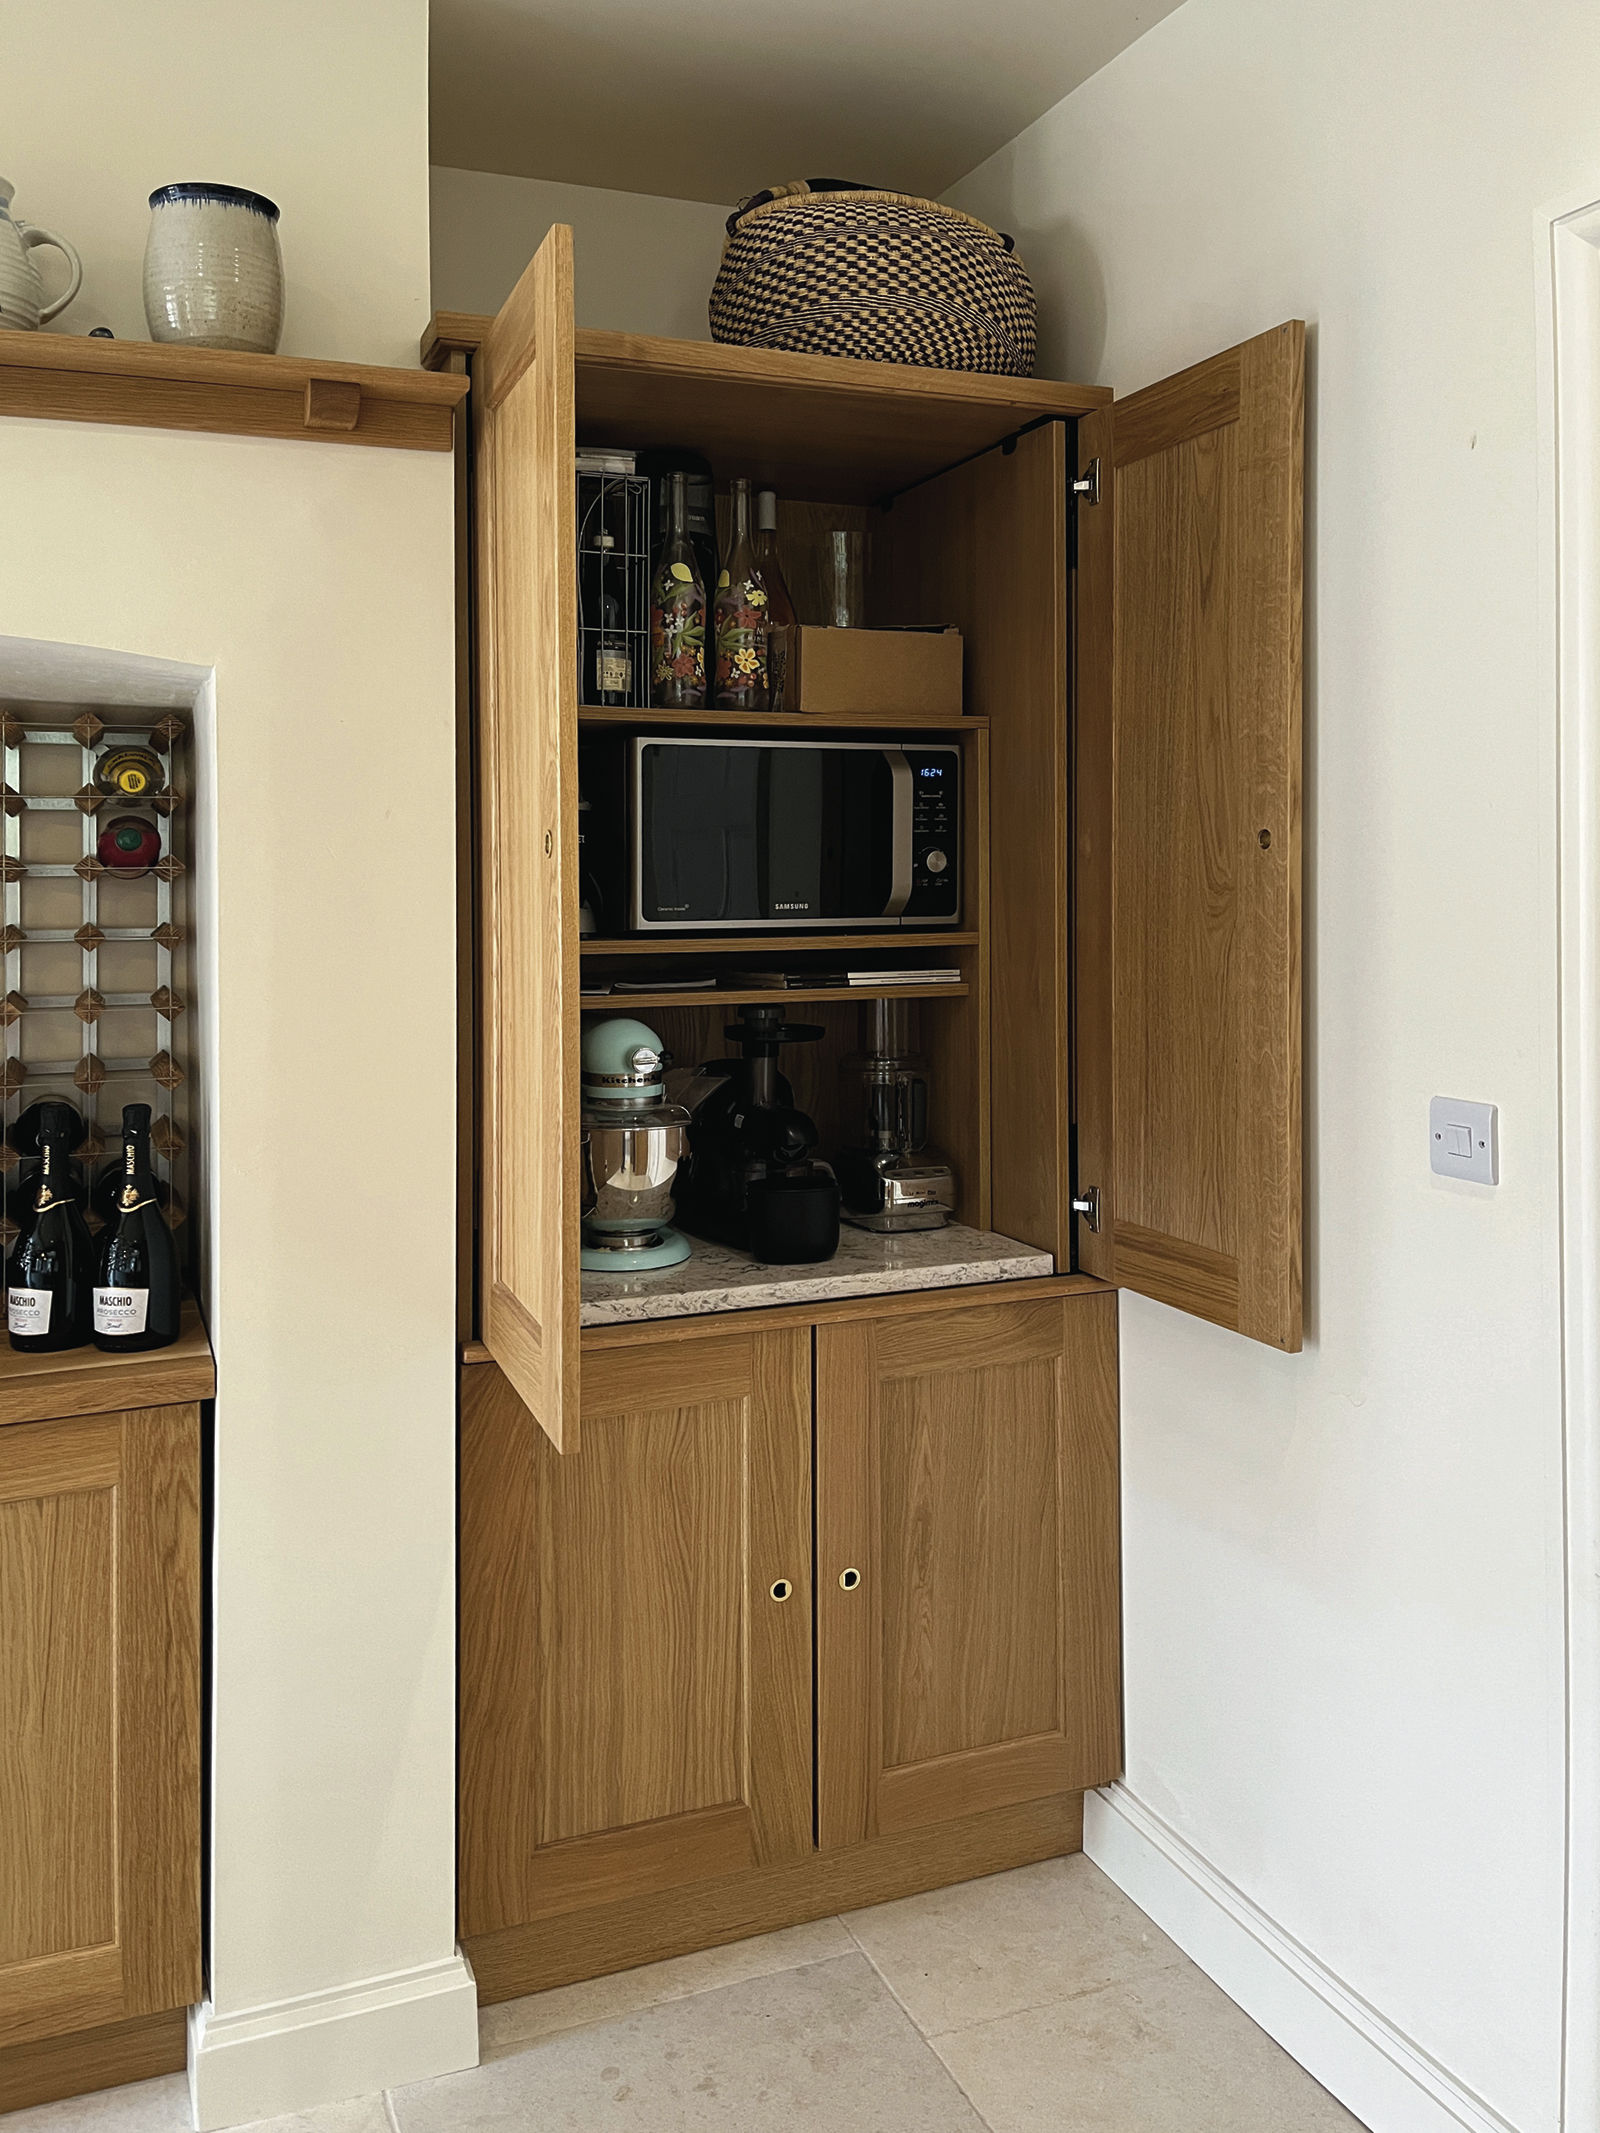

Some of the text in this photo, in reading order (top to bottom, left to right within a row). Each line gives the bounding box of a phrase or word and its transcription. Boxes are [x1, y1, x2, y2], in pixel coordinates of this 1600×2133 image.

[775, 902, 809, 910] SAMSUNG
[125, 1144, 135, 1175] MASCHIO
[99, 1295, 133, 1307] MASCHIO
[97, 1307, 137, 1316] PROSECCO
